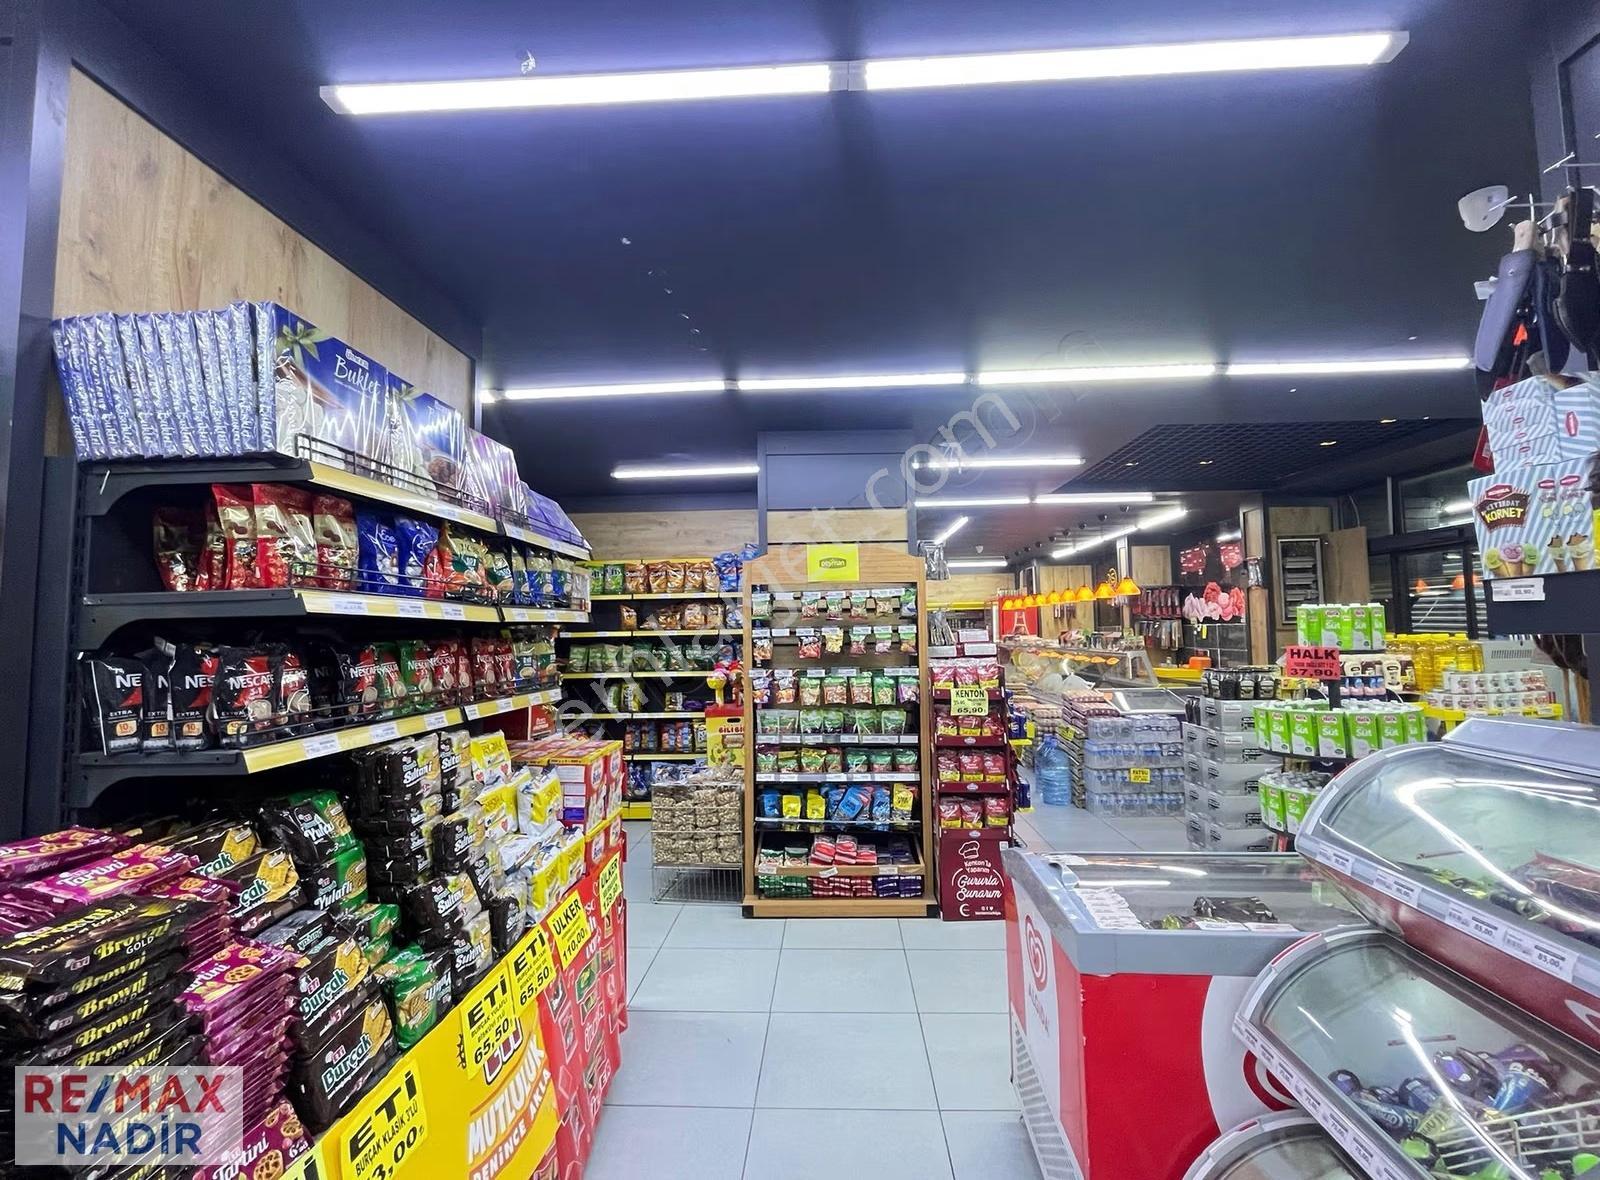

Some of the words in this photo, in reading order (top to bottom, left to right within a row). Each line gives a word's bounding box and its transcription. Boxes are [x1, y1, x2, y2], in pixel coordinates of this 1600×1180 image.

[335, 354, 380, 396] Buklet
[1481, 507, 1524, 523] KORNET
[1290, 649, 1336, 660] HALK
[955, 690, 984, 698] KENTON
[304, 823, 332, 841] Yula
[57, 859, 129, 887] Tartini
[239, 878, 272, 907] çak
[958, 875, 999, 888] Gururla
[956, 888, 1002, 901] Sunarım
[553, 898, 581, 935] ÜLKER
[94, 919, 171, 960] Browni
[126, 937, 154, 955] GOLD
[513, 930, 546, 976] ETİ
[562, 928, 586, 961] 110,00
[1537, 952, 1561, 968] 85,00
[72, 952, 146, 994] Browni
[300, 967, 349, 1021] Burçak
[519, 965, 550, 1007] 65,50
[77, 972, 148, 1019] Browni
[467, 974, 508, 1030] ETİ
[76, 1000, 149, 1047] Browni
[474, 1018, 509, 1065] 65,50
[322, 1033, 373, 1093] Burçak
[350, 1070, 417, 1162] ETİ
[468, 1033, 545, 1165] MUTLULUK
[212, 1131, 269, 1180] Tartini
[355, 1136, 383, 1177] BURÇAK
[382, 1114, 405, 1150] KLASİK
[366, 1126, 418, 1180] 3,00
